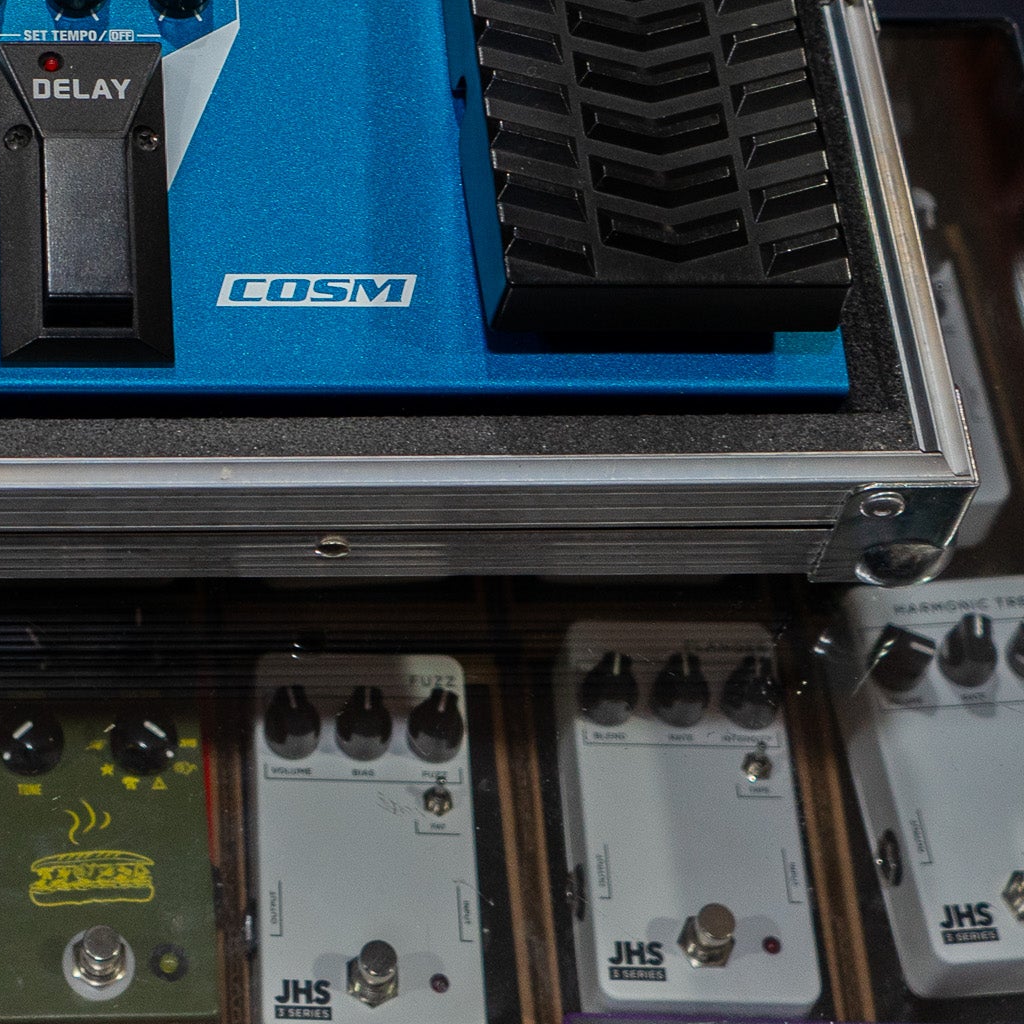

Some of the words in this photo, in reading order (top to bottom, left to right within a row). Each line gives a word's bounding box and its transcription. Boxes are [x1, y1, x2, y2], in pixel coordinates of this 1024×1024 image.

[24, 30, 50, 42] SET
[32, 78, 131, 99] DELAY
[228, 278, 409, 302] COSM
[940, 902, 993, 928] JHS
[608, 940, 664, 966] JHS
[275, 979, 331, 1005] JHS
[288, 1009, 329, 1019] SERIES
